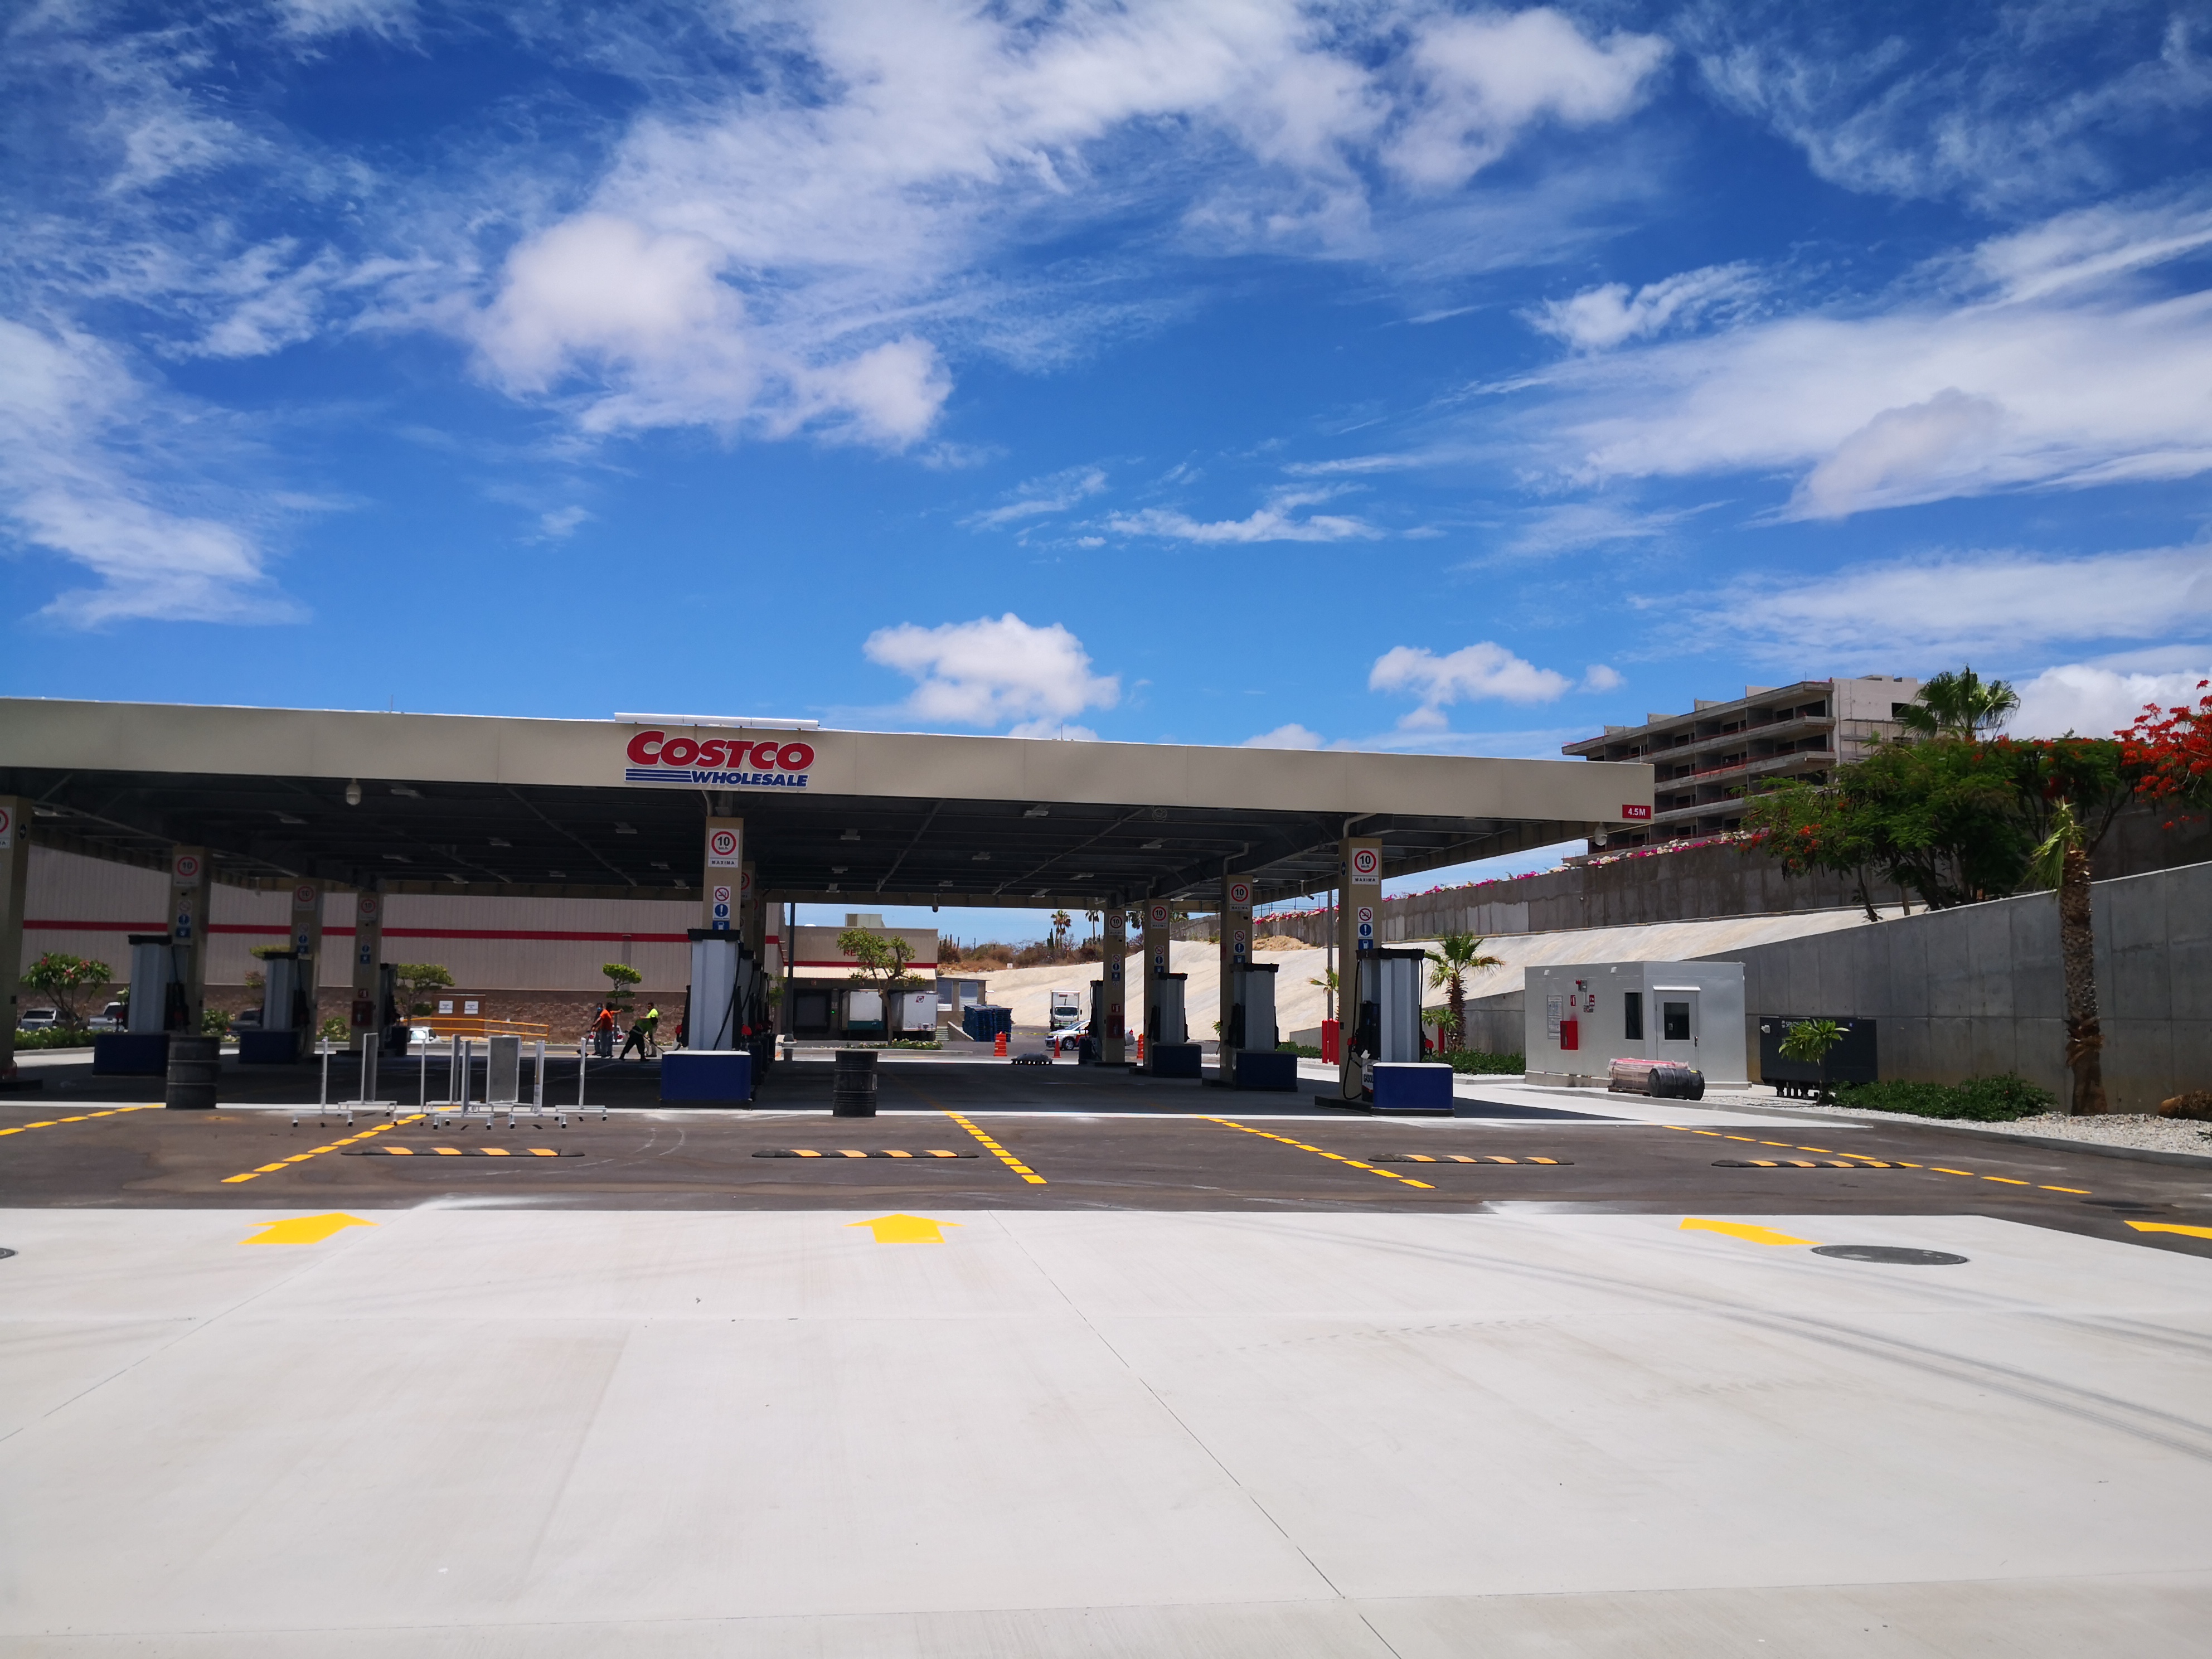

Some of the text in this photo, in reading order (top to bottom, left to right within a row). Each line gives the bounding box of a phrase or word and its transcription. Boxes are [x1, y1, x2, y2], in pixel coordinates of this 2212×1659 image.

[627, 730, 815, 771] COSTCO
[691, 770, 808, 787] WHOLESALE
[1628, 808, 1646, 816] 4.5M
[717, 837, 730, 846] 10
[1360, 855, 1371, 865] 10
[182, 862, 193, 870] 10
